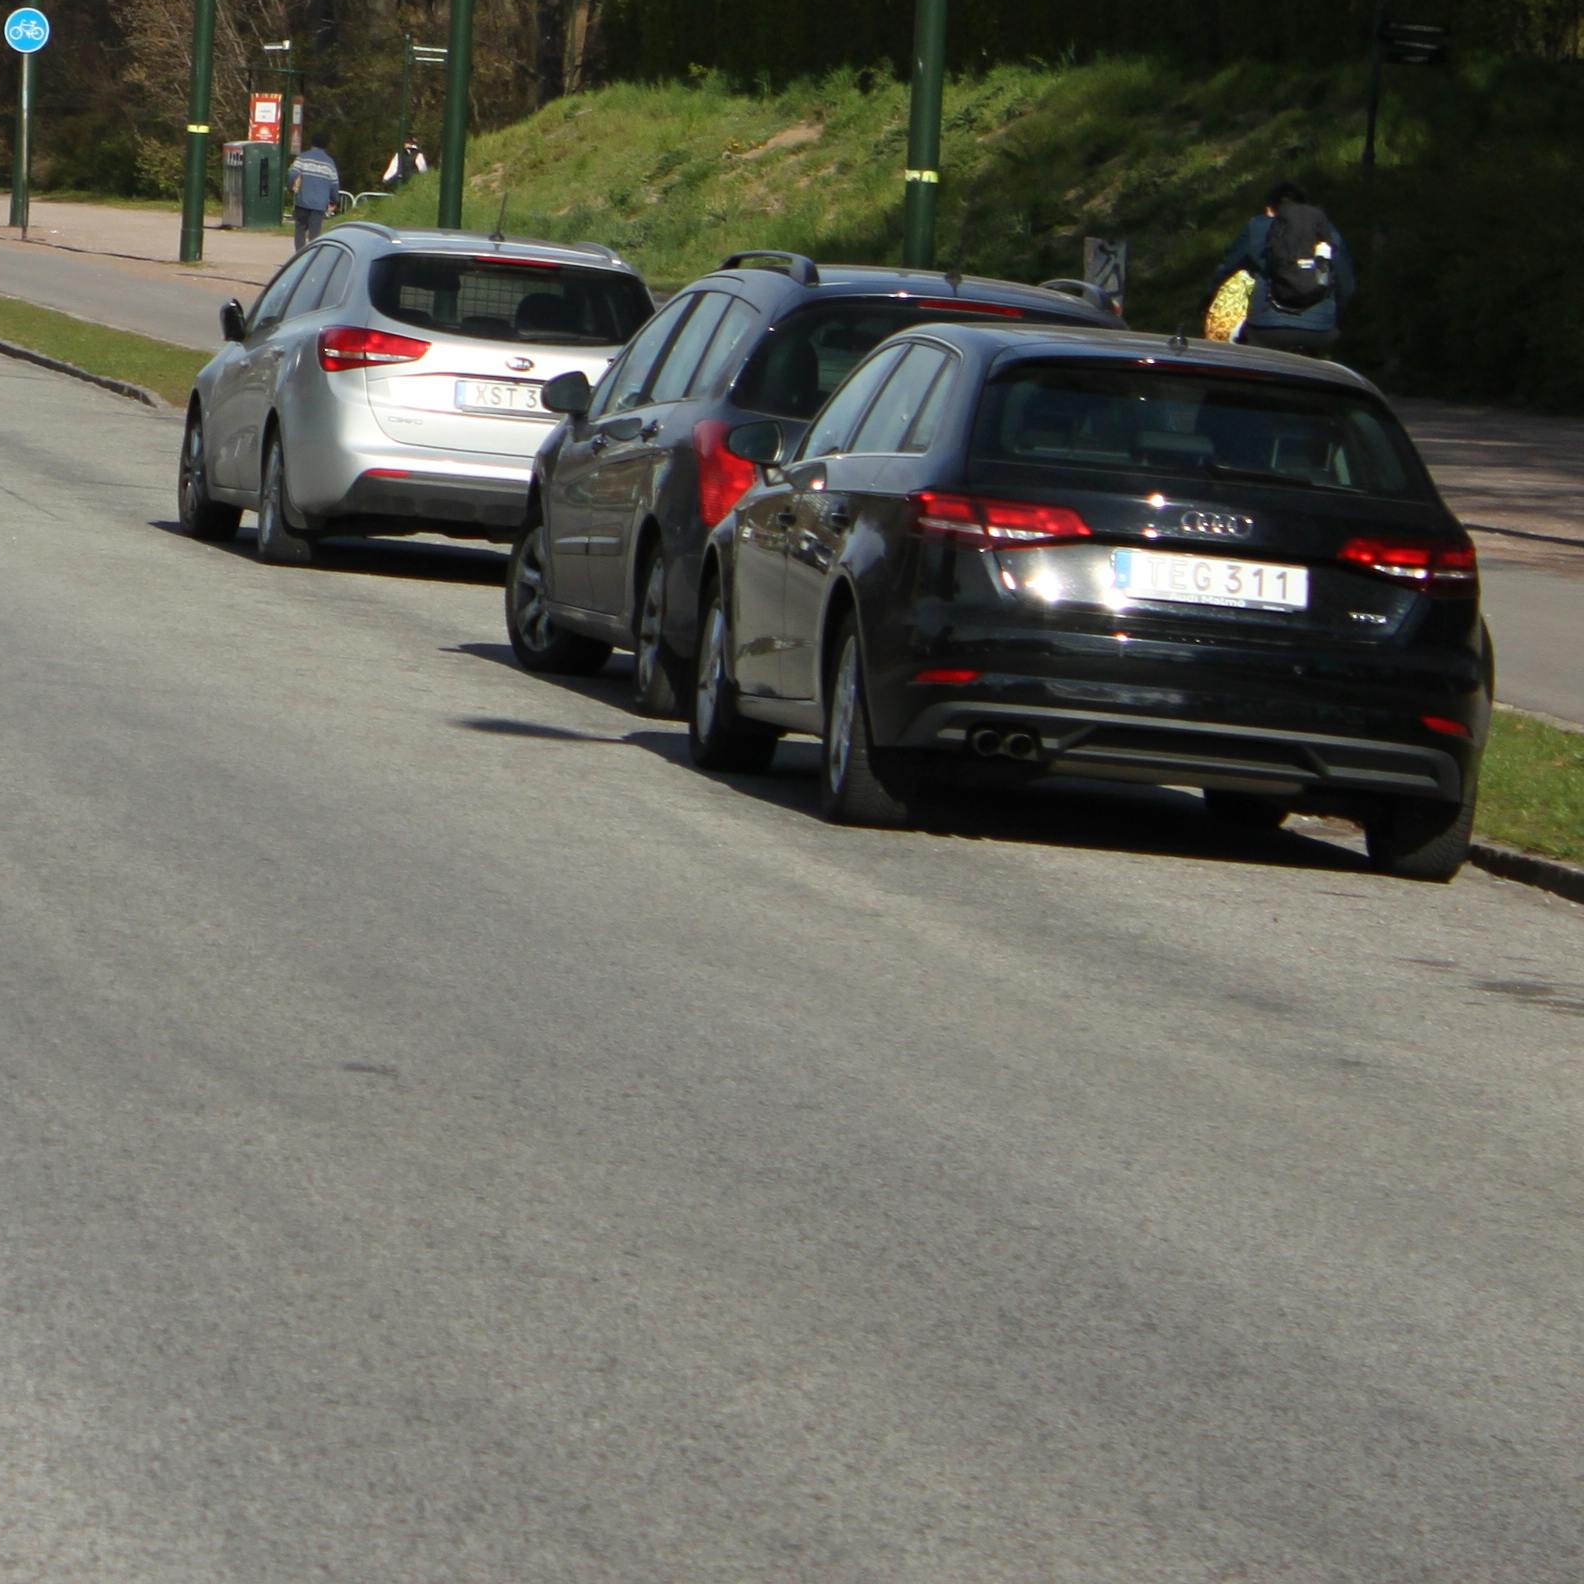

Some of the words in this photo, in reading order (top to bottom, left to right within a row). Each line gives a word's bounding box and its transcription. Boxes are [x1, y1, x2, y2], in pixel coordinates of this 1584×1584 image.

[476, 384, 518, 406] XST
[526, 390, 537, 408] 3
[1148, 559, 1211, 592] TEG
[1225, 565, 1288, 600] 311
